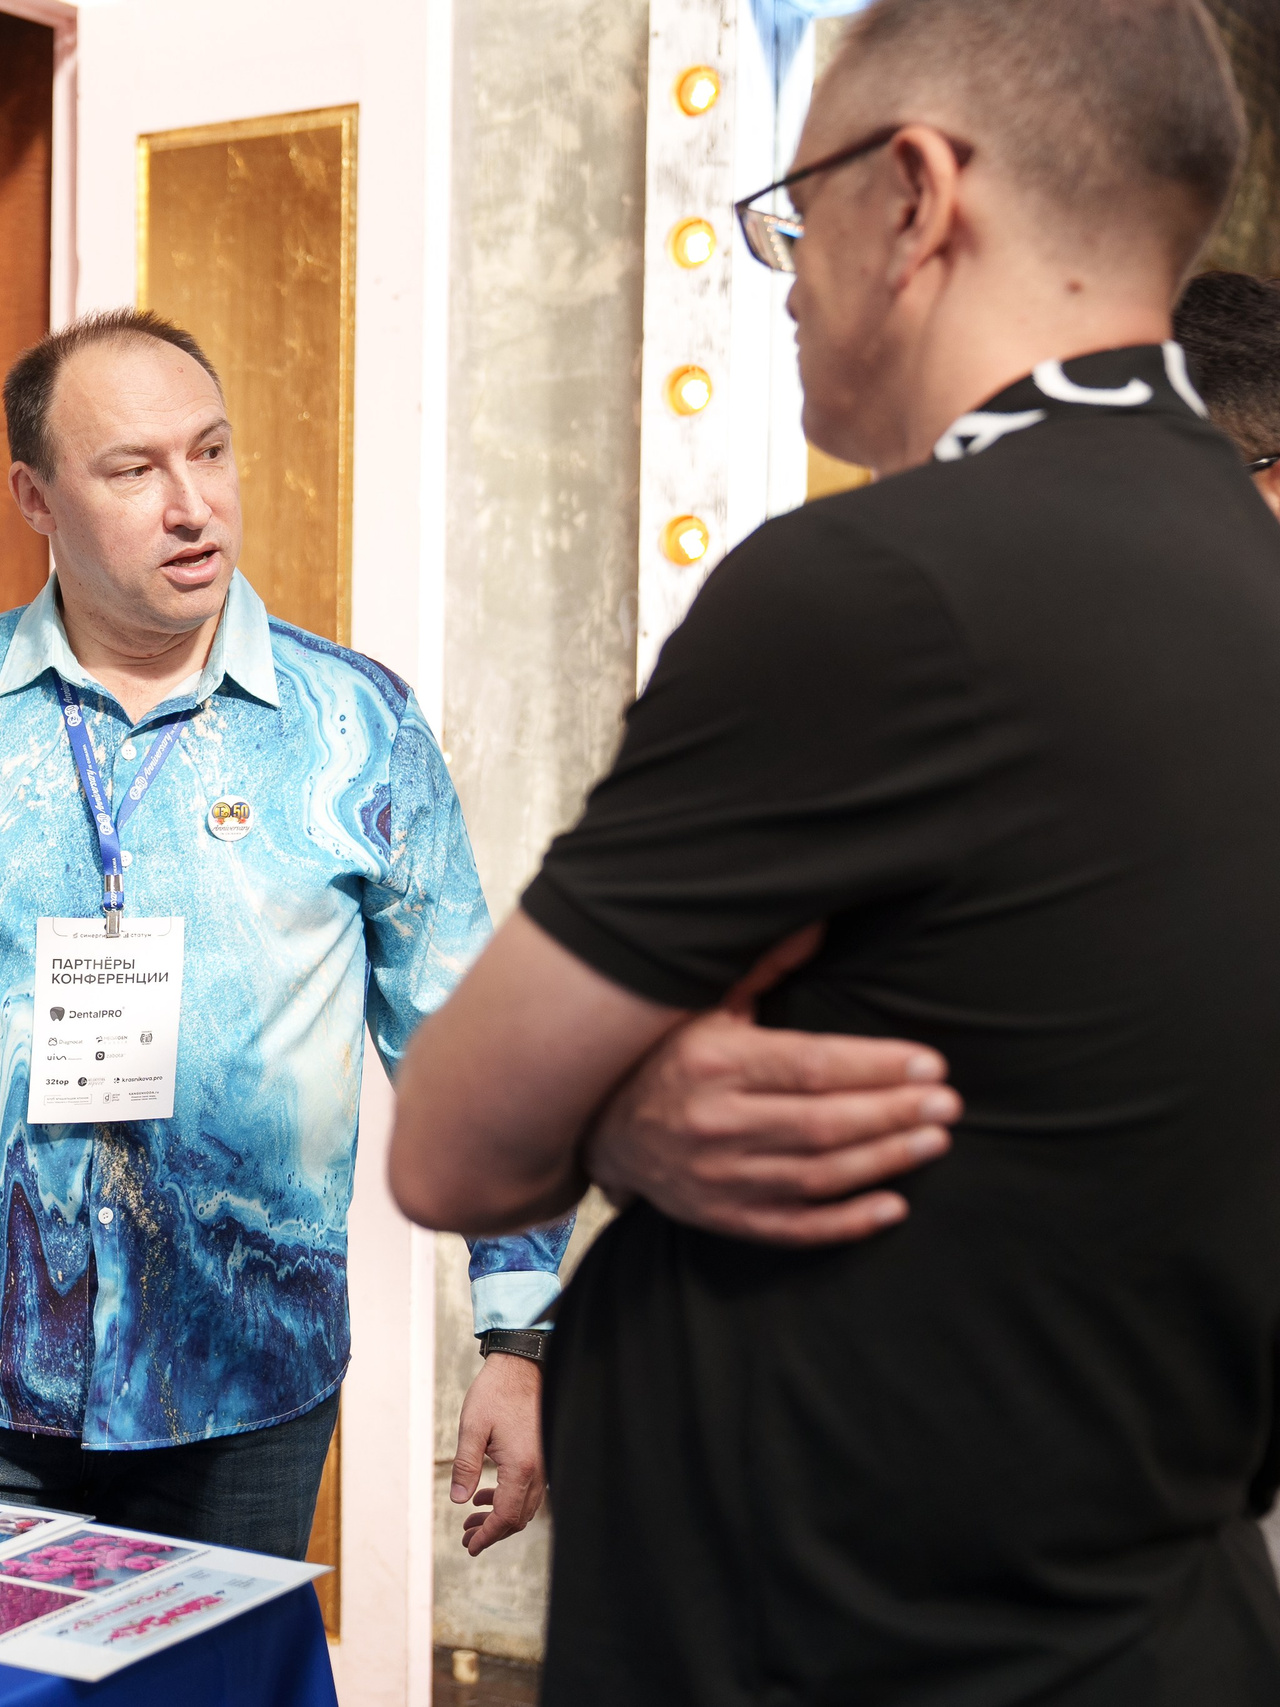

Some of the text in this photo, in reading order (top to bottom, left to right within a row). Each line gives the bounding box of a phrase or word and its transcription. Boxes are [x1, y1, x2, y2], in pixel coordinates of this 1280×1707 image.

[52, 957, 135, 970] ПАРТНЁРЫ
[51, 972, 168, 984] КОНФЕРЕНЦИИ
[69, 1009, 122, 1019] DentalPRO
[46, 1075, 163, 1087] 32top krasnikova.pro
